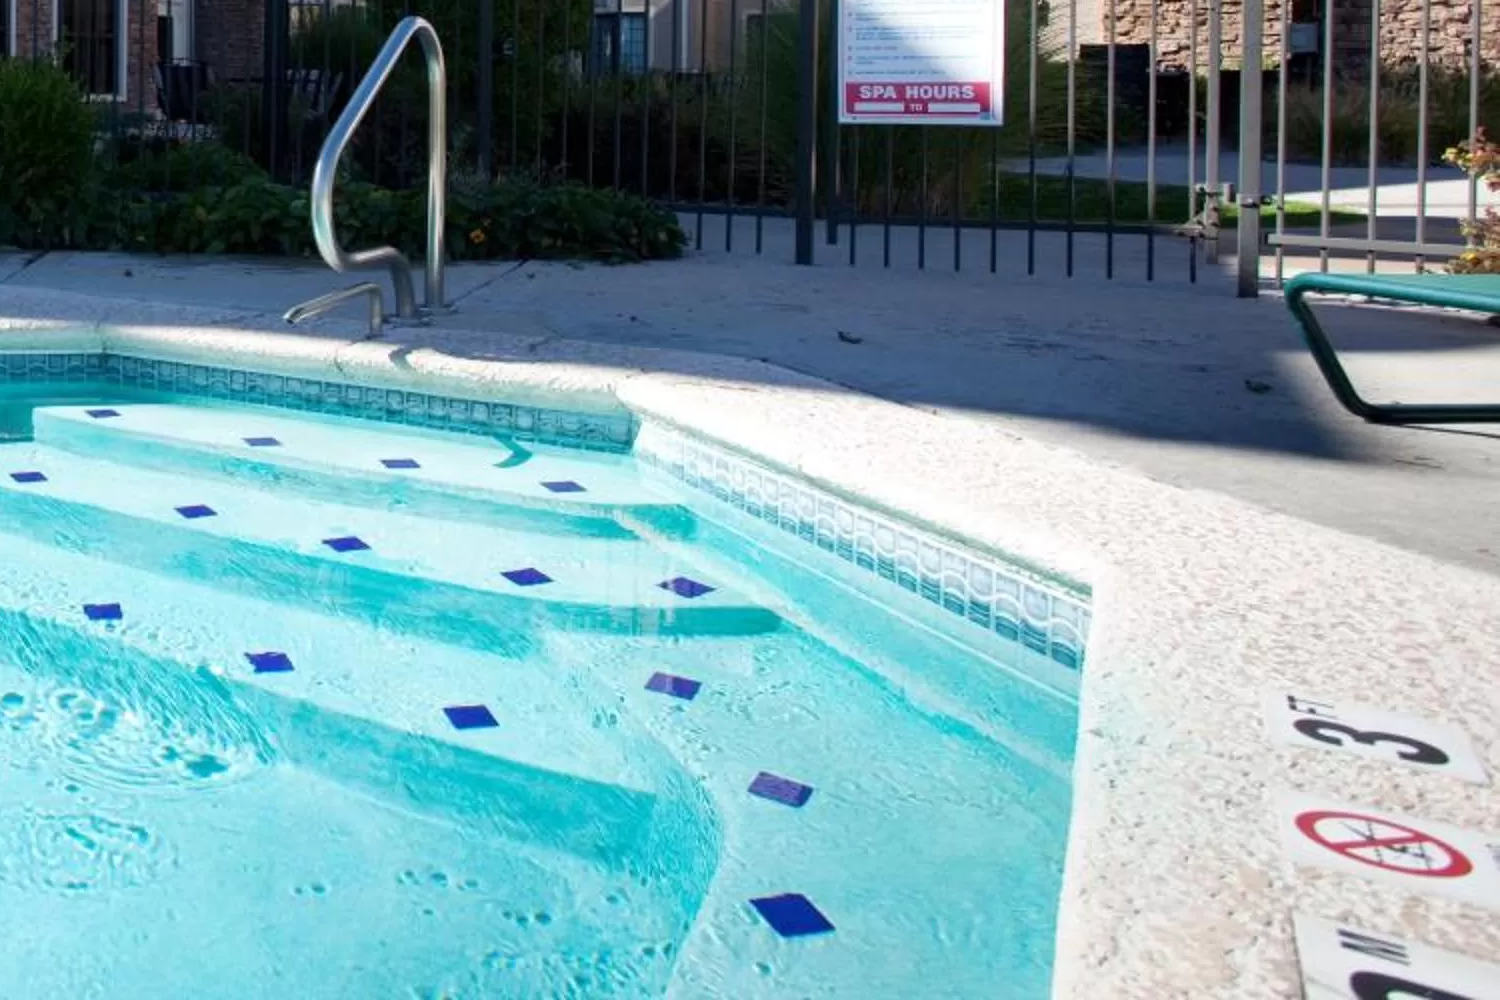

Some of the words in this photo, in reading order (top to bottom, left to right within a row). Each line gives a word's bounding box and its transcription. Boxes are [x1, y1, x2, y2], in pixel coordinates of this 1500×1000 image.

[858, 84, 898, 99] SPA
[905, 84, 976, 99] HOURS
[909, 103, 924, 112] TO
[1293, 718, 1450, 765] 3
